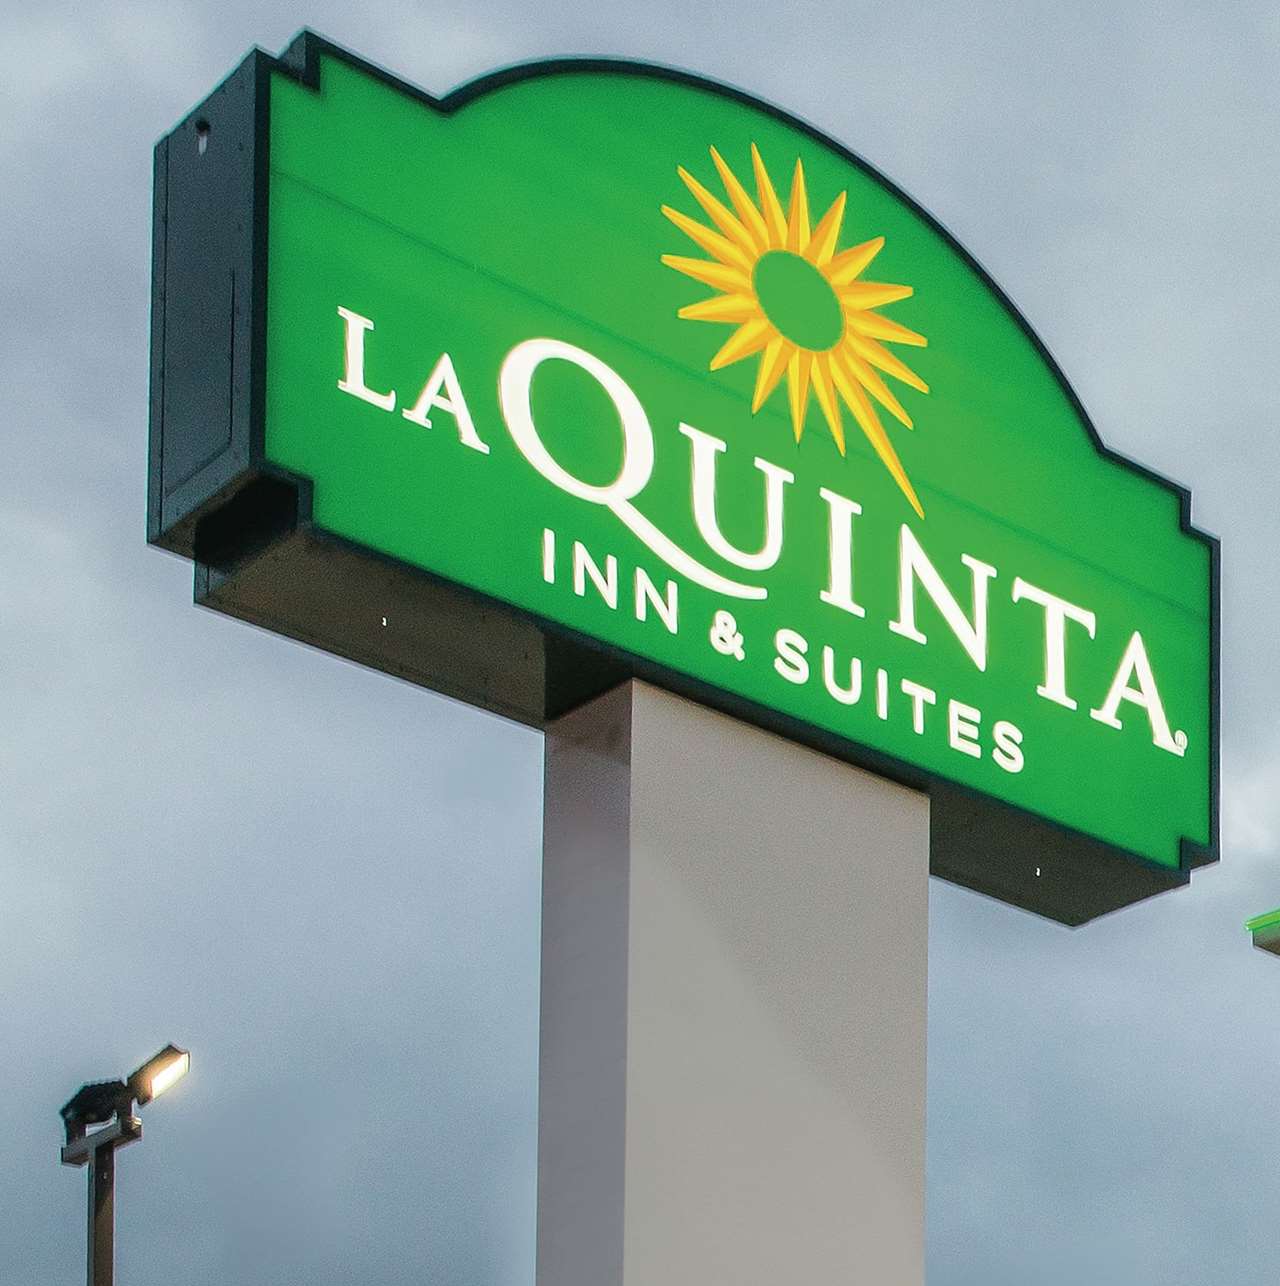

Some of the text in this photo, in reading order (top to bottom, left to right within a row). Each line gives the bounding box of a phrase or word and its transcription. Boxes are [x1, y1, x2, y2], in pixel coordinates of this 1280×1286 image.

[337, 304, 490, 455] LA
[542, 527, 1026, 774] INN & SUITES
